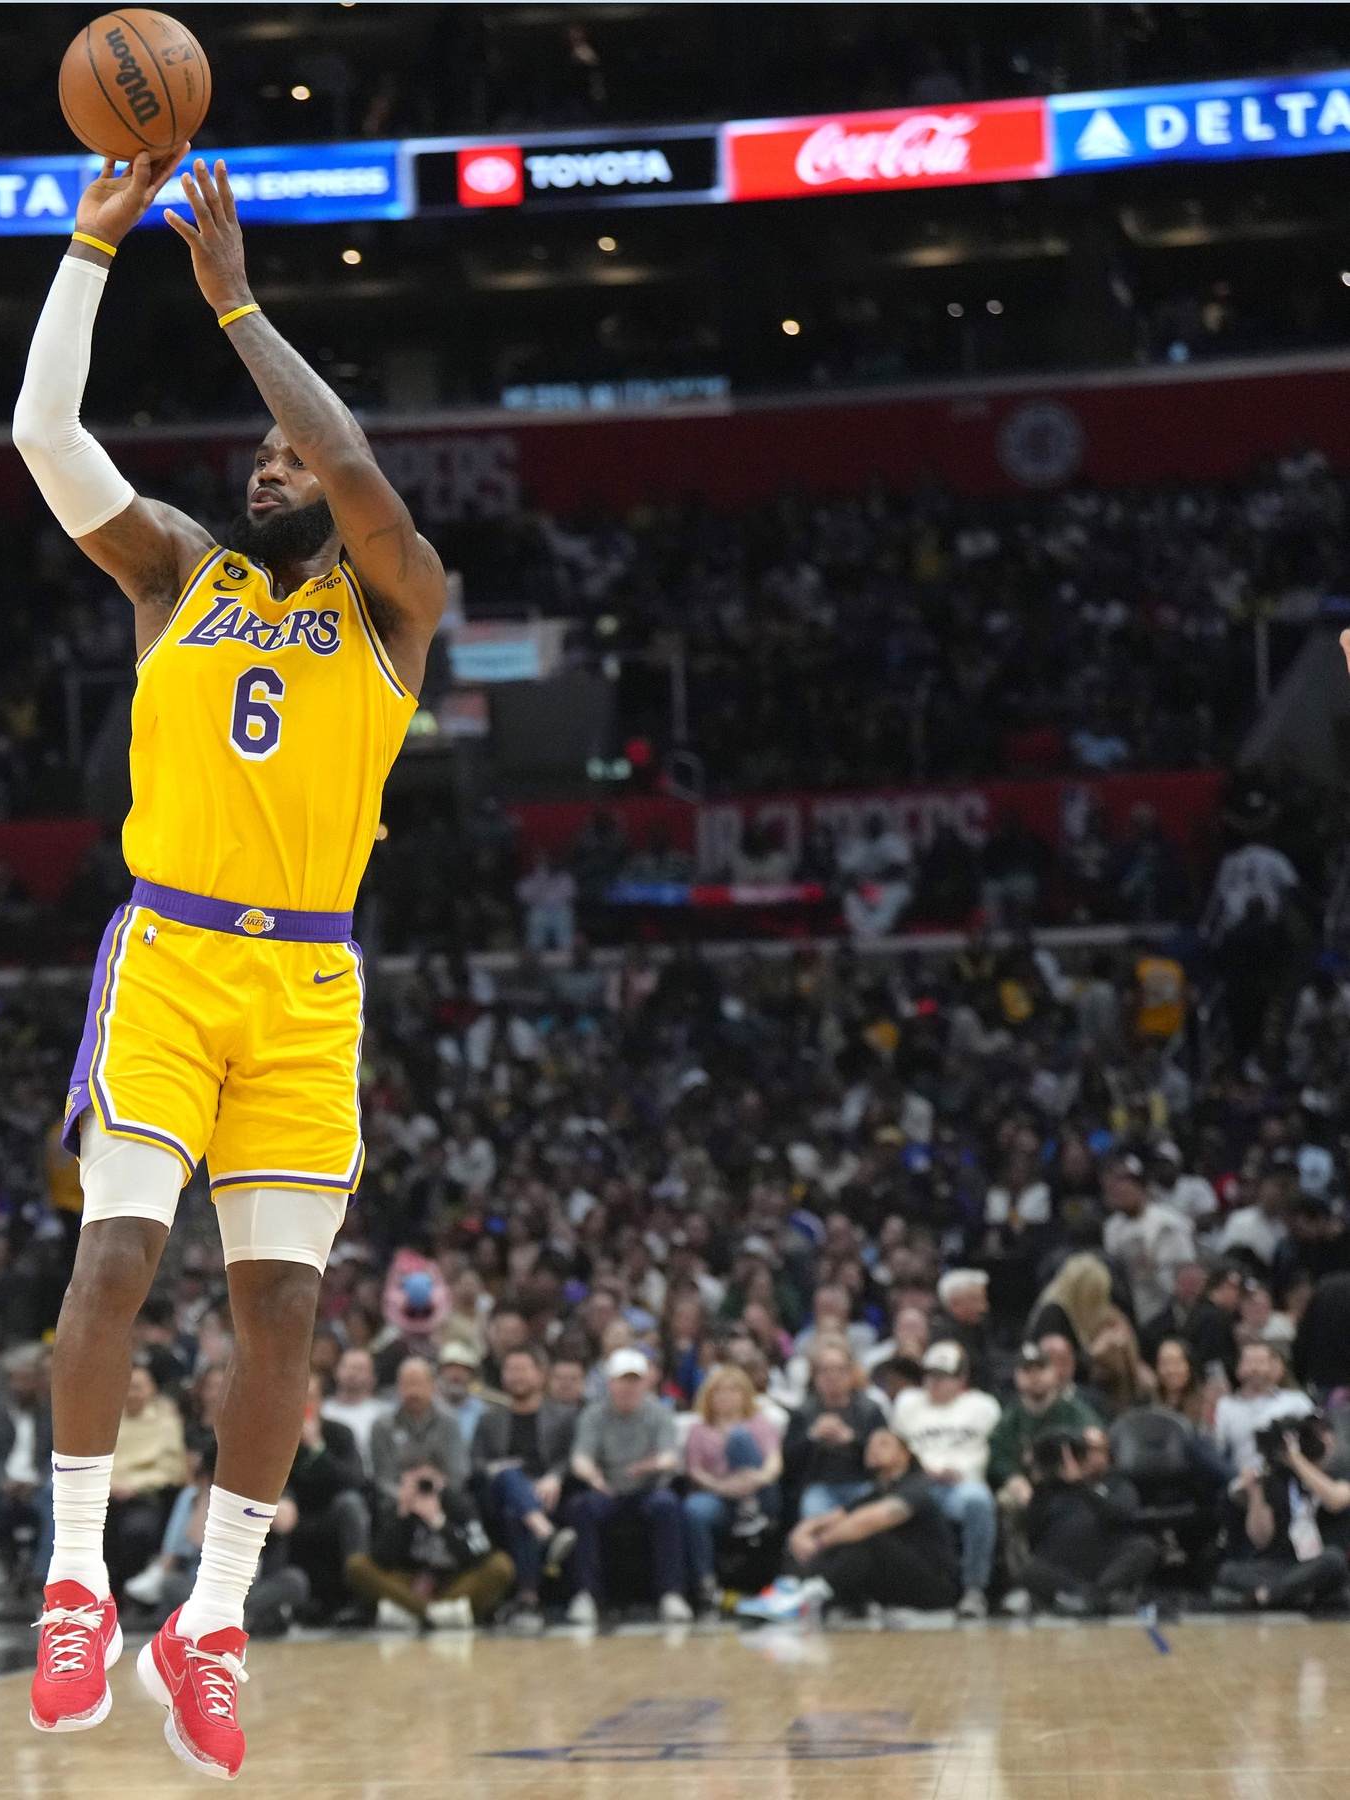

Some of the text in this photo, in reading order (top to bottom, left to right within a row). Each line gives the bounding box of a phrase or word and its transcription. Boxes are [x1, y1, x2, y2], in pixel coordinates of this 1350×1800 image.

[1144, 89, 1350, 150] DELTA
[525, 150, 672, 188] TOYOTA
[305, 576, 342, 597] bibigo
[176, 596, 342, 657] LAKERS
[228, 665, 285, 762] 6
